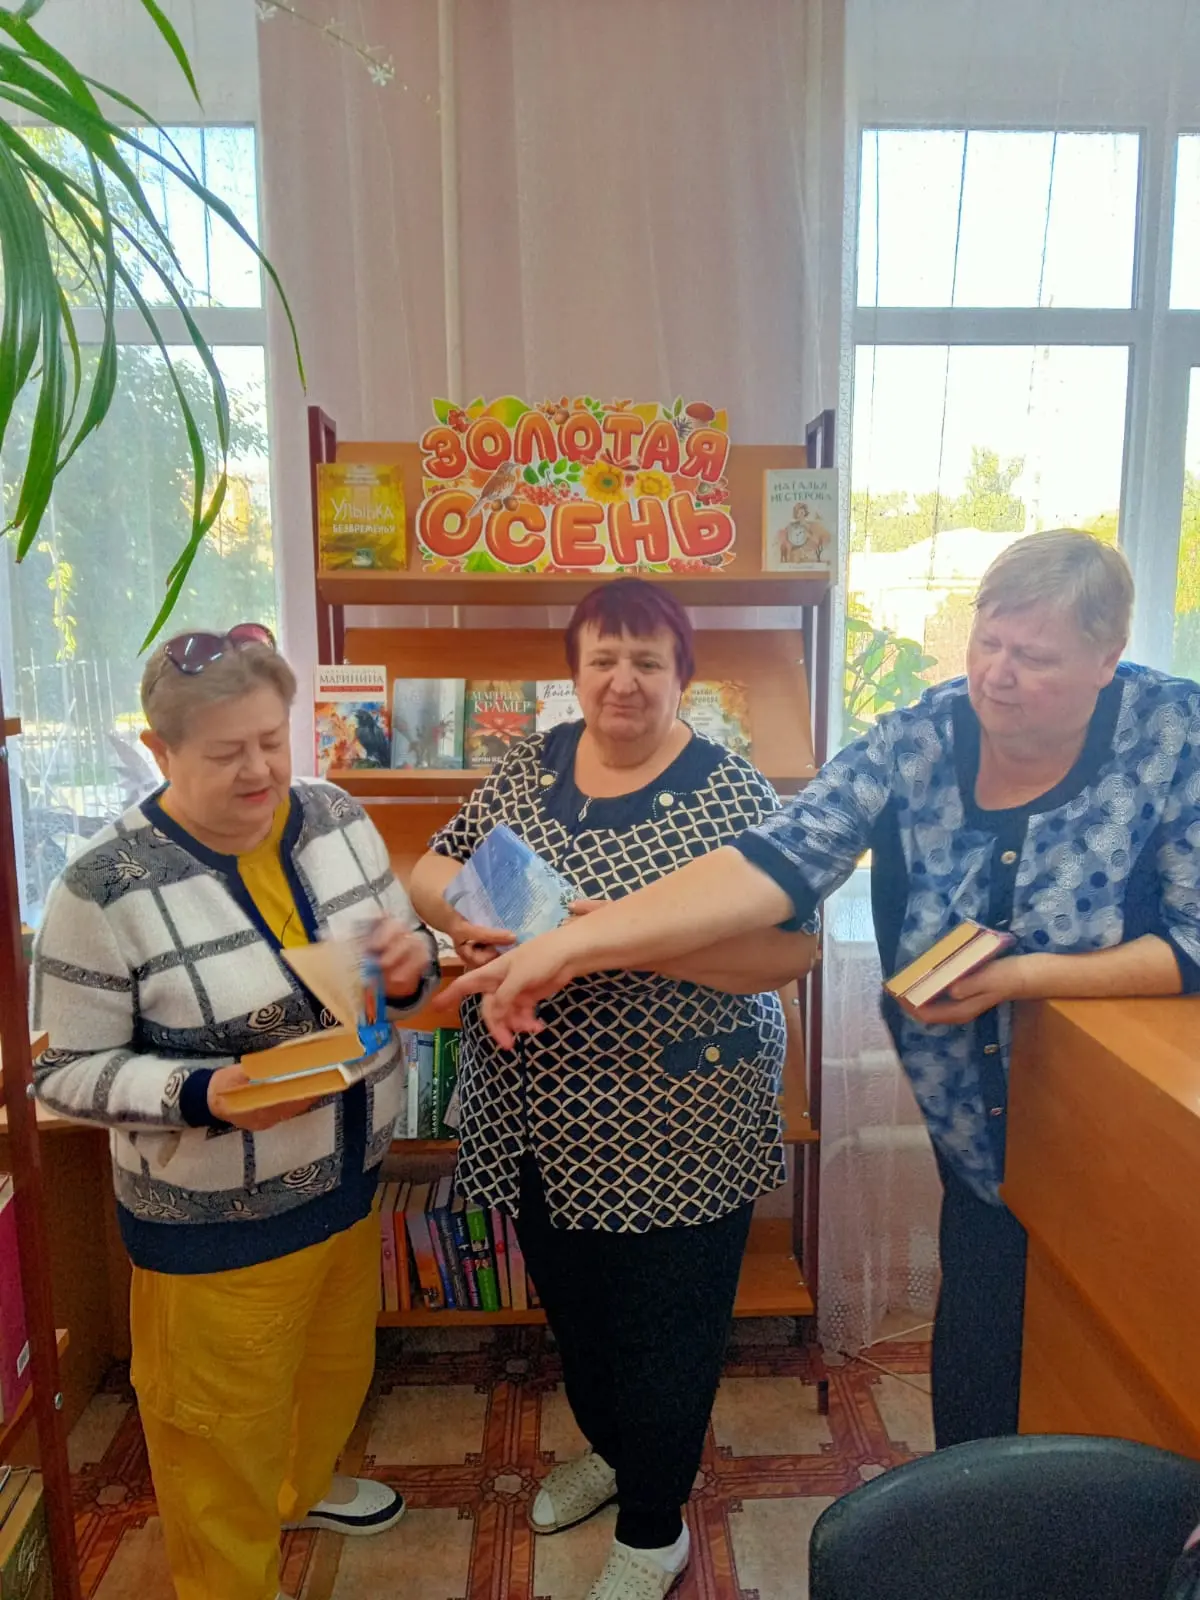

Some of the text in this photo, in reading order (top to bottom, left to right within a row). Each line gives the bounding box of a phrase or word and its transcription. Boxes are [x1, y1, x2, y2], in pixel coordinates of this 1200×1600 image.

[421, 411, 729, 482] ЗОЛОТАЯ
[419, 489, 734, 566] ОСЕНЬ
[320, 673, 385, 684] МАРИНИНА
[474, 700, 531, 713] КРАМЕР
